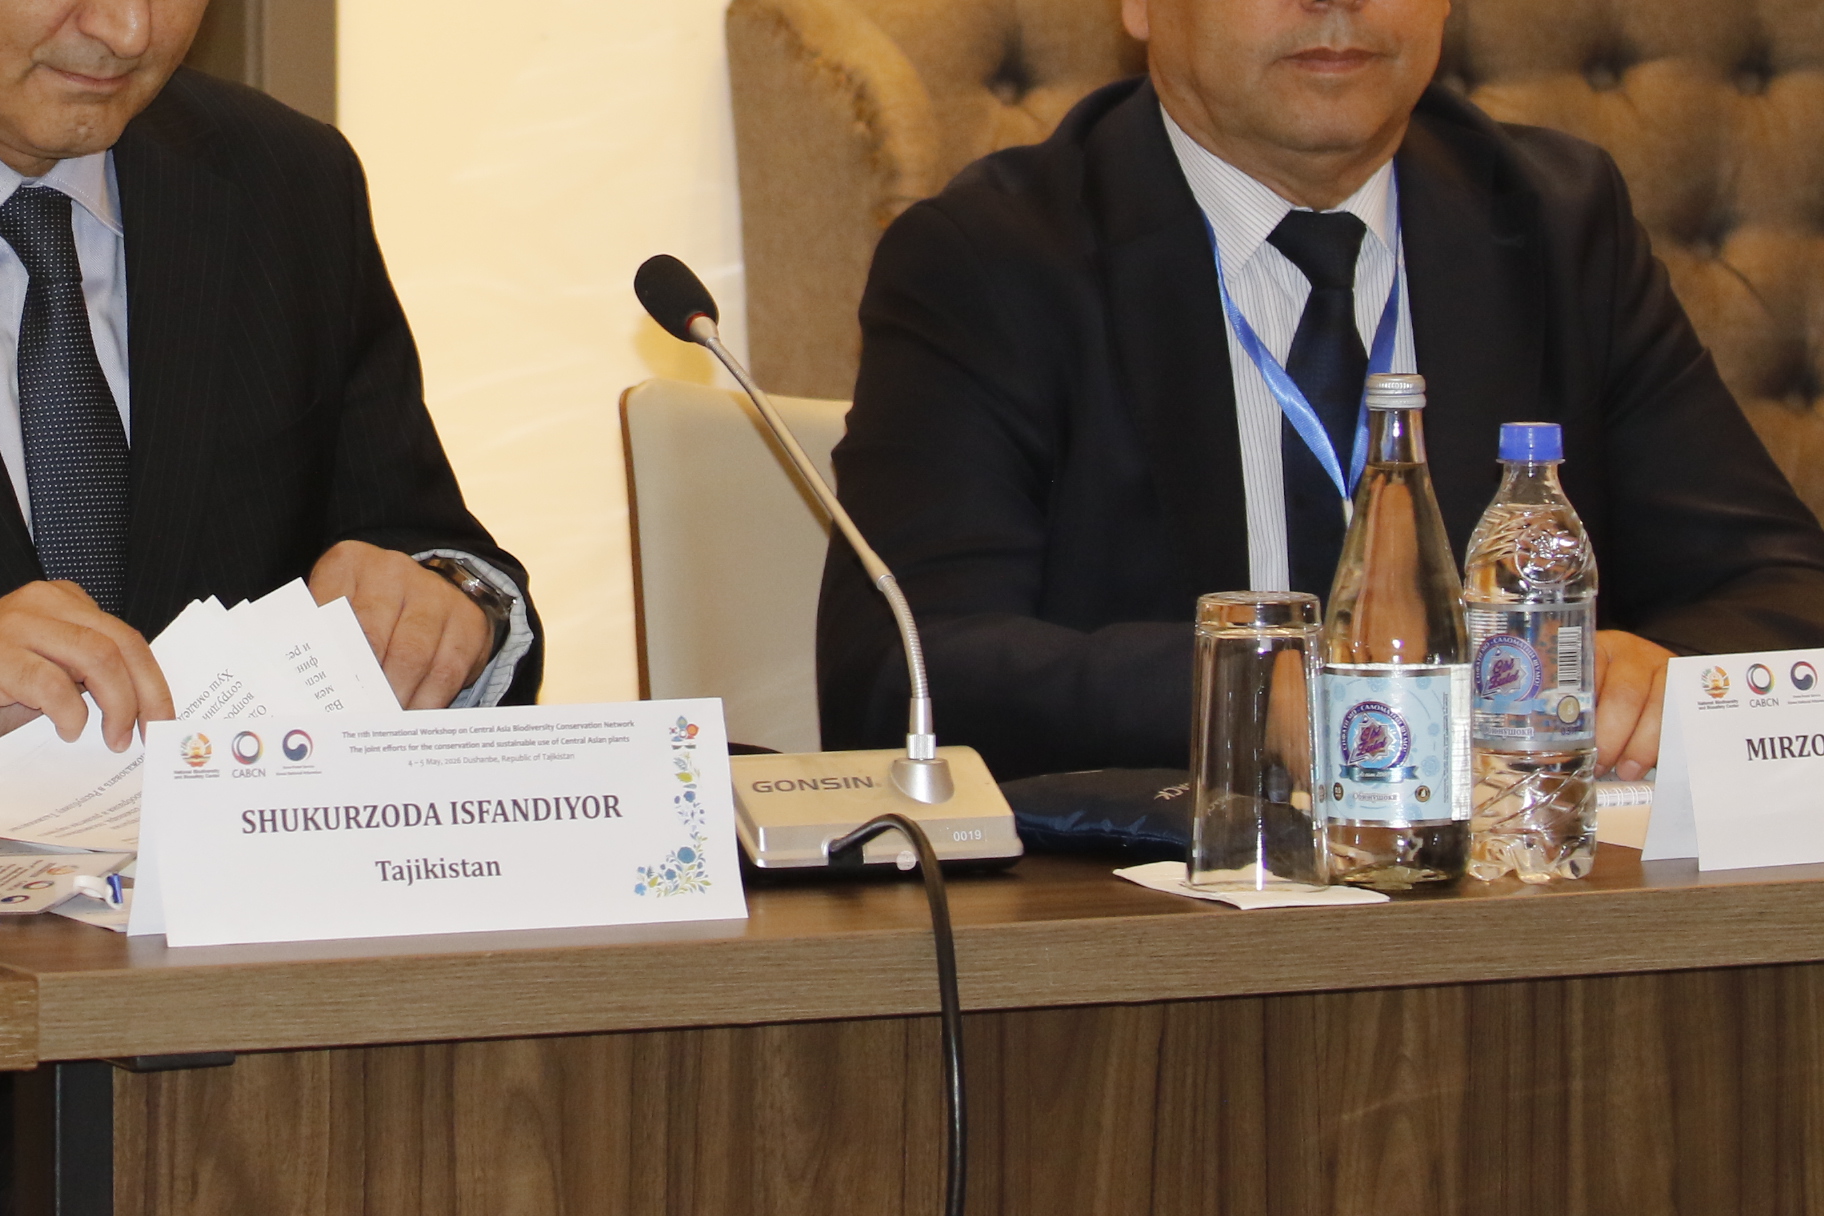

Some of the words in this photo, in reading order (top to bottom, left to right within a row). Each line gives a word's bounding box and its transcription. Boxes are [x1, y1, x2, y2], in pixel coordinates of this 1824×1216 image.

[209, 668, 234, 692] Хуш
[305, 670, 327, 686] исп
[223, 691, 254, 720] вопро
[1749, 698, 1780, 709] CABCN
[342, 731, 356, 739] The
[372, 728, 418, 737] International
[419, 727, 457, 736] Workshop
[469, 726, 495, 734] Central
[512, 724, 554, 733] Biodiversity
[556, 722, 602, 731] Conservation
[603, 720, 635, 728] Network
[364, 745, 381, 754] joint
[382, 744, 407, 752] efforts
[408, 743, 419, 751] for
[420, 743, 433, 751] the
[433, 741, 480, 750] conservation
[496, 739, 536, 748] sustainable
[560, 736, 586, 745] Central
[587, 736, 607, 744] Asian
[607, 736, 630, 745] plants
[1745, 733, 1824, 762] MIRZO
[501, 754, 532, 763] Republic
[533, 753, 541, 761] of
[542, 752, 575, 761] Tajikistan
[232, 768, 267, 779] CABCN
[752, 775, 873, 794] GONSIN
[240, 799, 444, 836] SHUKURZODA
[449, 793, 624, 826] ISFANDIYOR
[952, 829, 982, 842] 0019
[374, 855, 503, 887] Tajikistan
